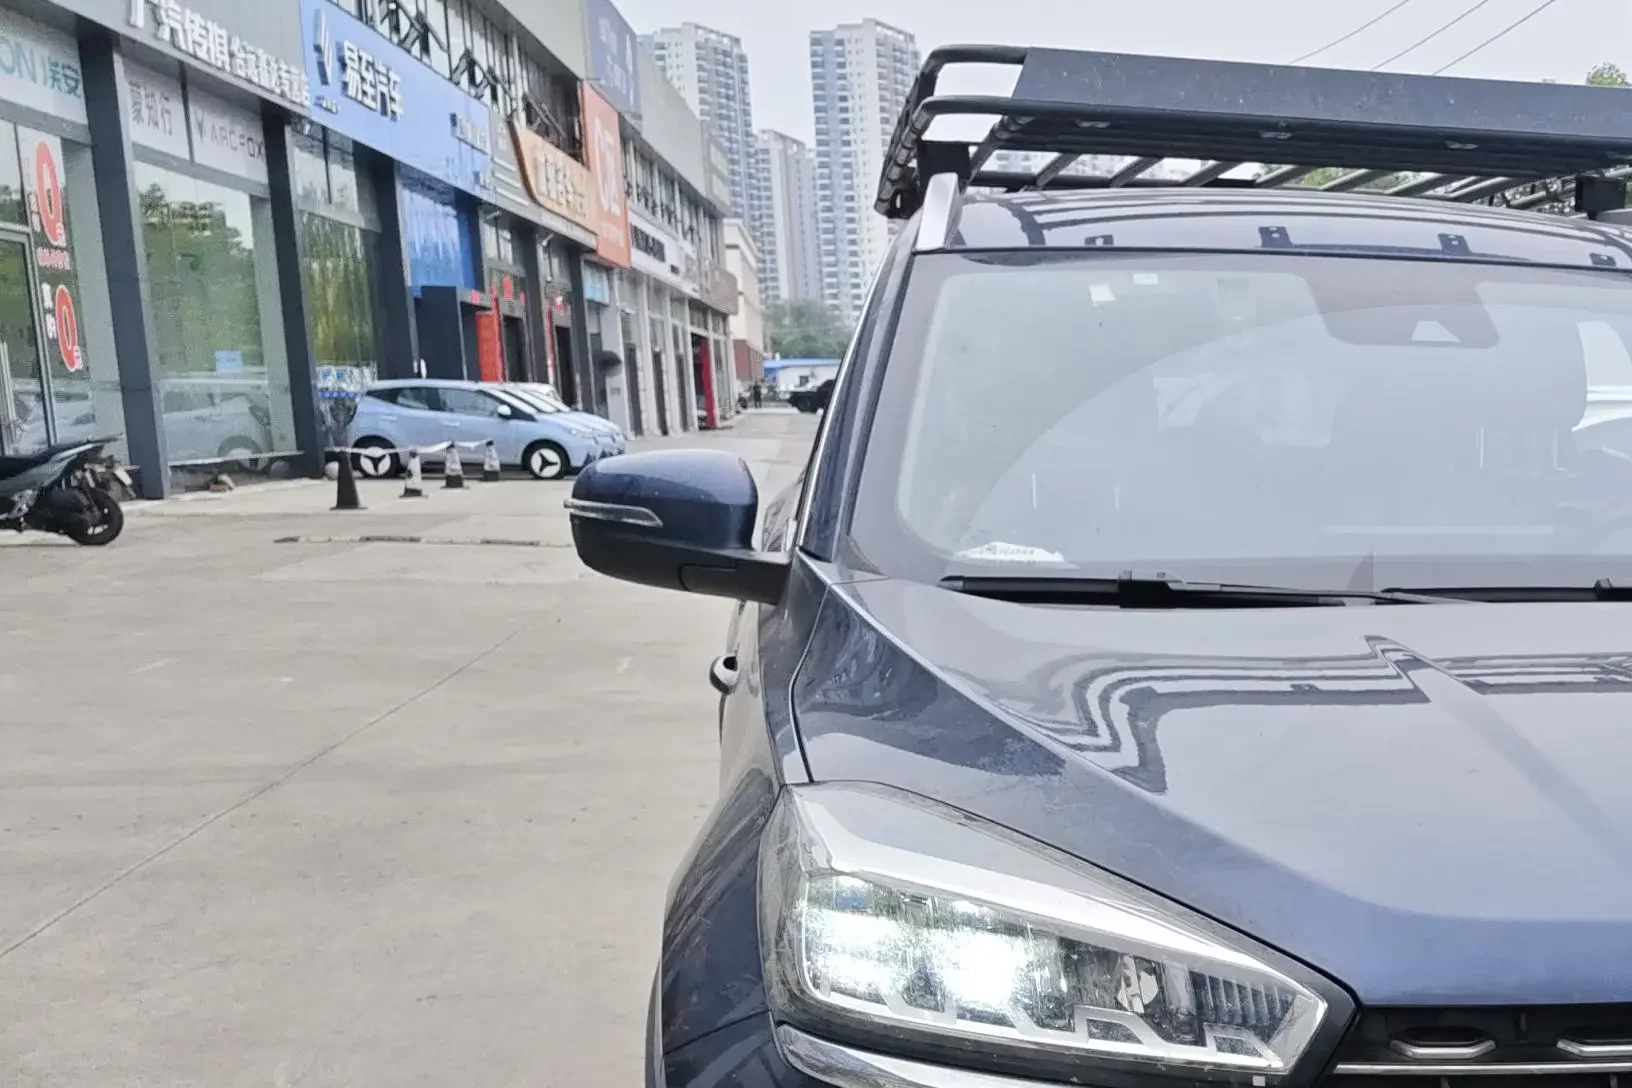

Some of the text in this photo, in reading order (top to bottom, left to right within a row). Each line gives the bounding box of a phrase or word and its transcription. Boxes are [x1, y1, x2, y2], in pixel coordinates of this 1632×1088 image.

[342, 40, 403, 121] 易至汽车
[210, 122, 265, 161] ARCFOX
